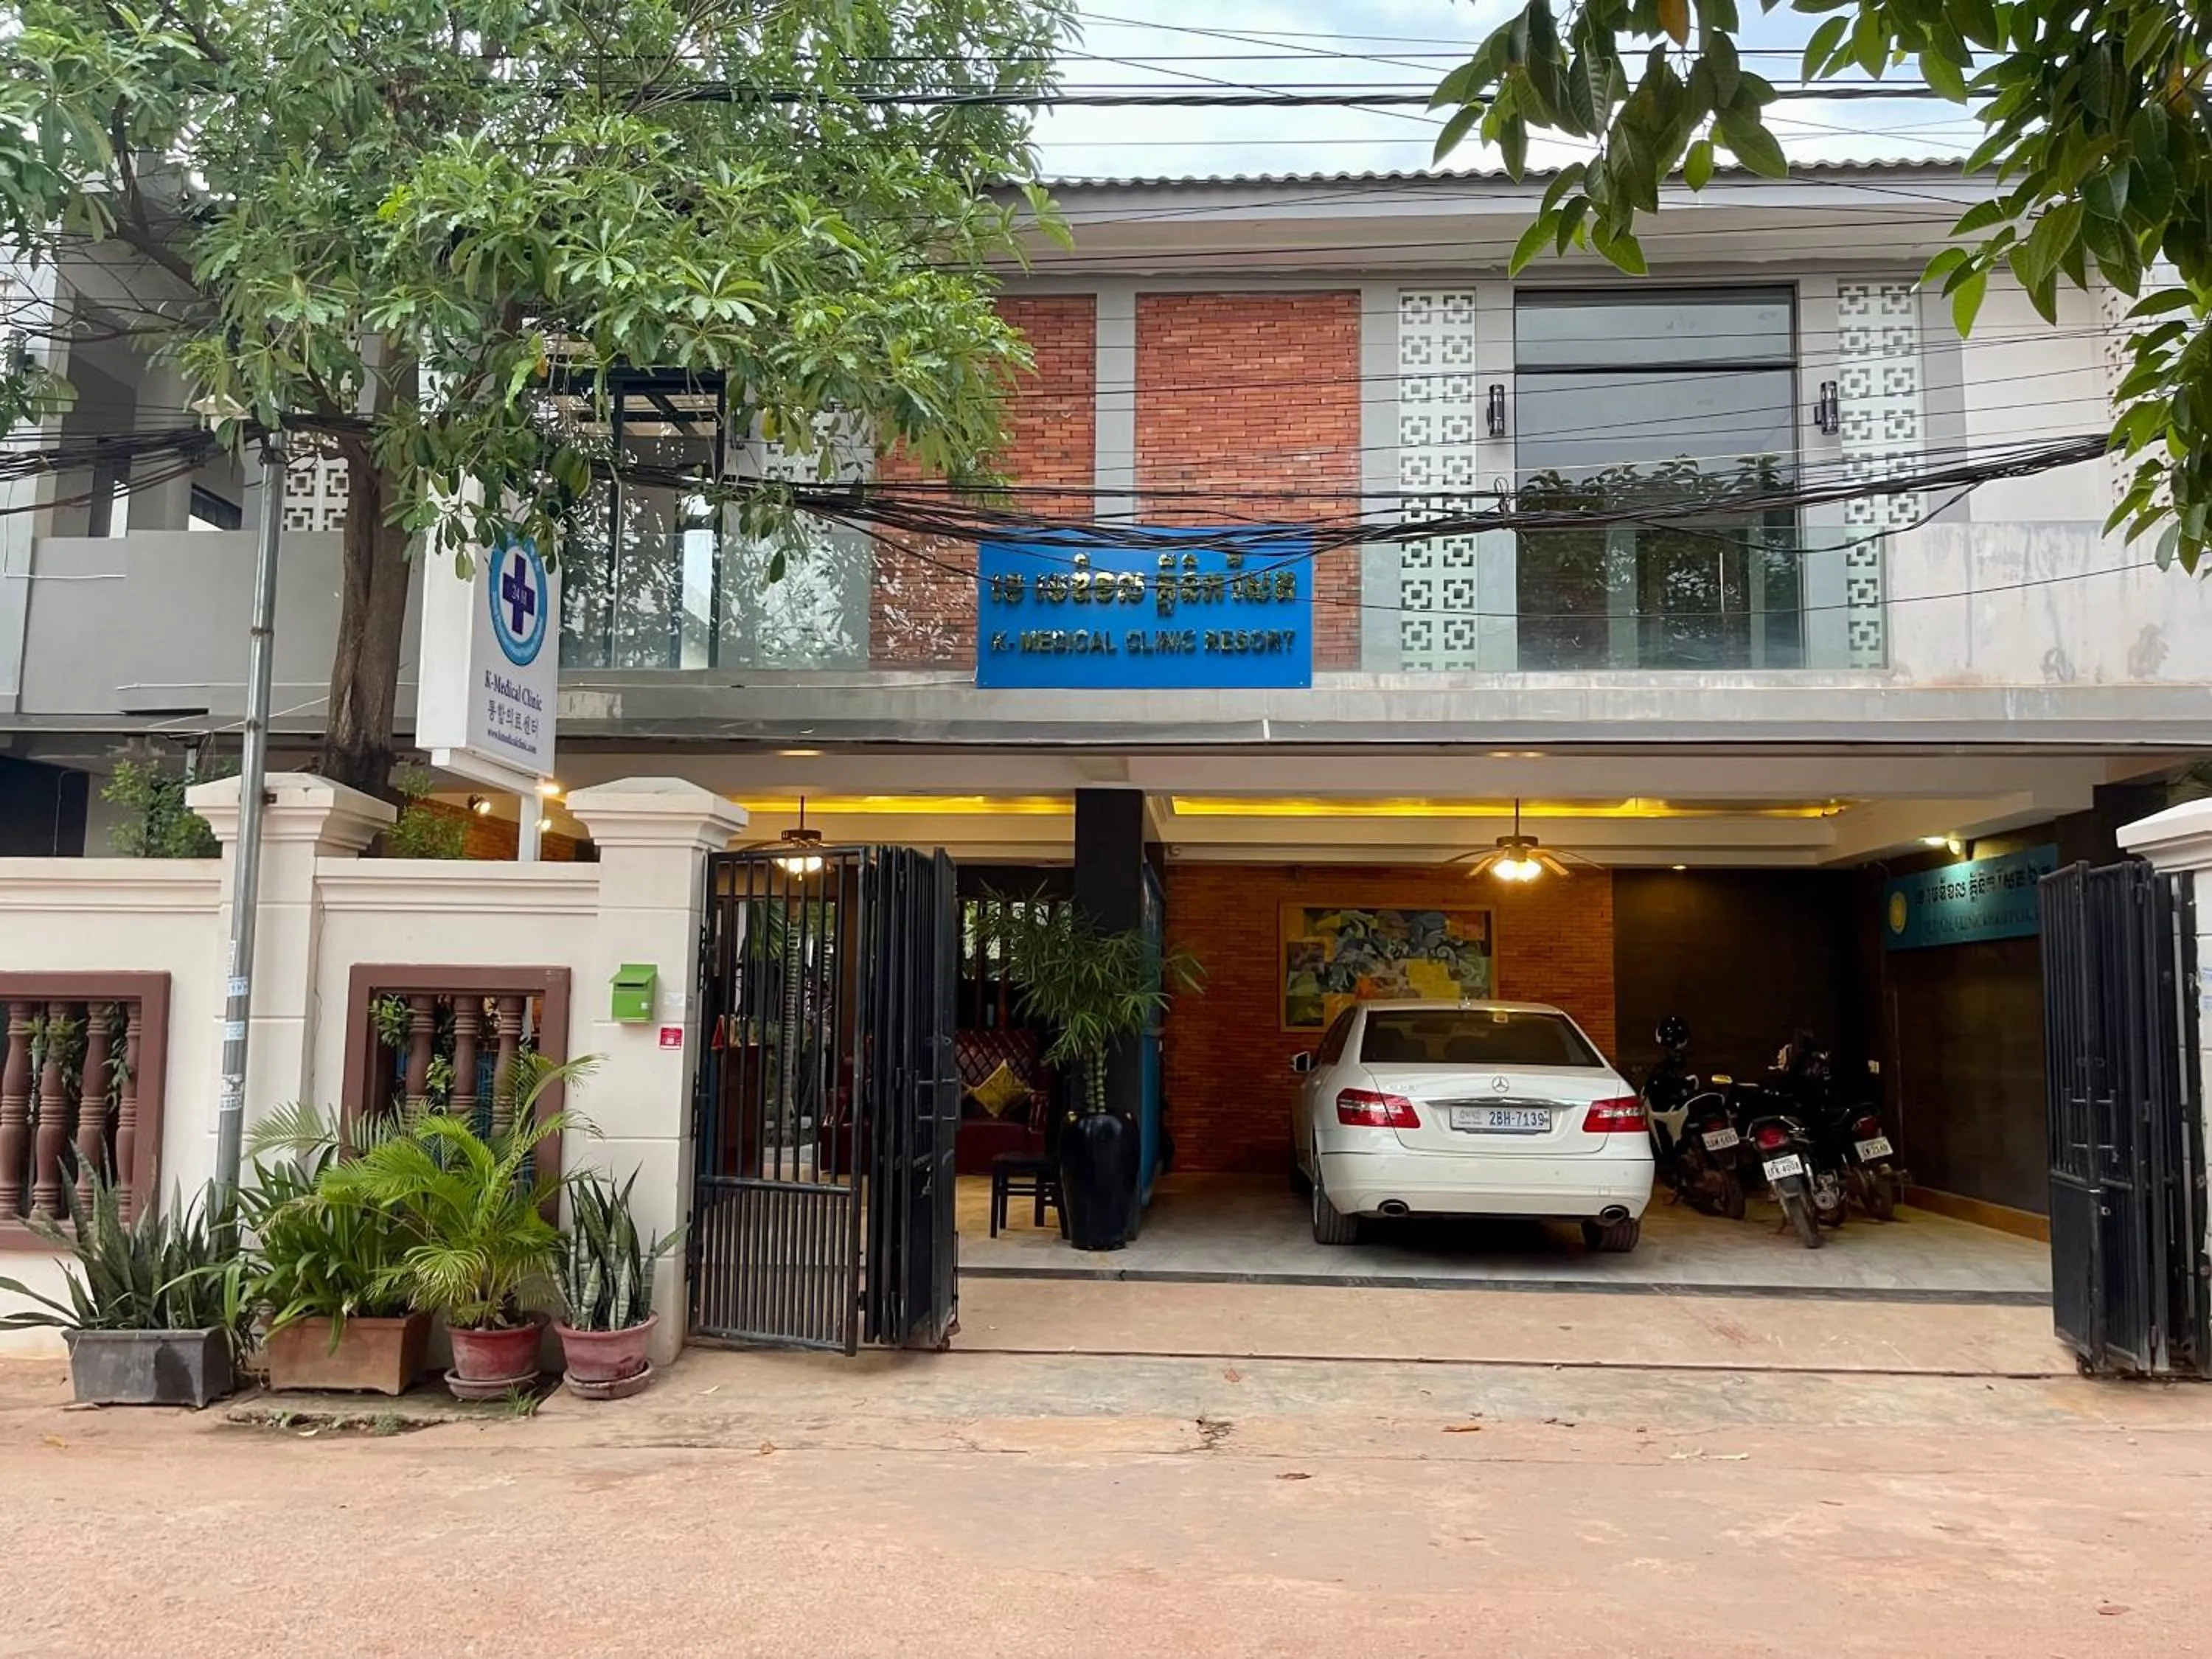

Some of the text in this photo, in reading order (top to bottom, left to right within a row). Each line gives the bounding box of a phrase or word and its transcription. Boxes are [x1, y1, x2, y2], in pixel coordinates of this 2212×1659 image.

[1020, 630, 1117, 653] MEDICAL
[1125, 630, 1197, 653] CLINIC
[1204, 630, 1296, 653] RESORT
[485, 669, 542, 712] K-Medical Clinic
[488, 699, 539, 738] 통합의료센터
[1489, 1110, 1545, 1126] 2BH-7139
